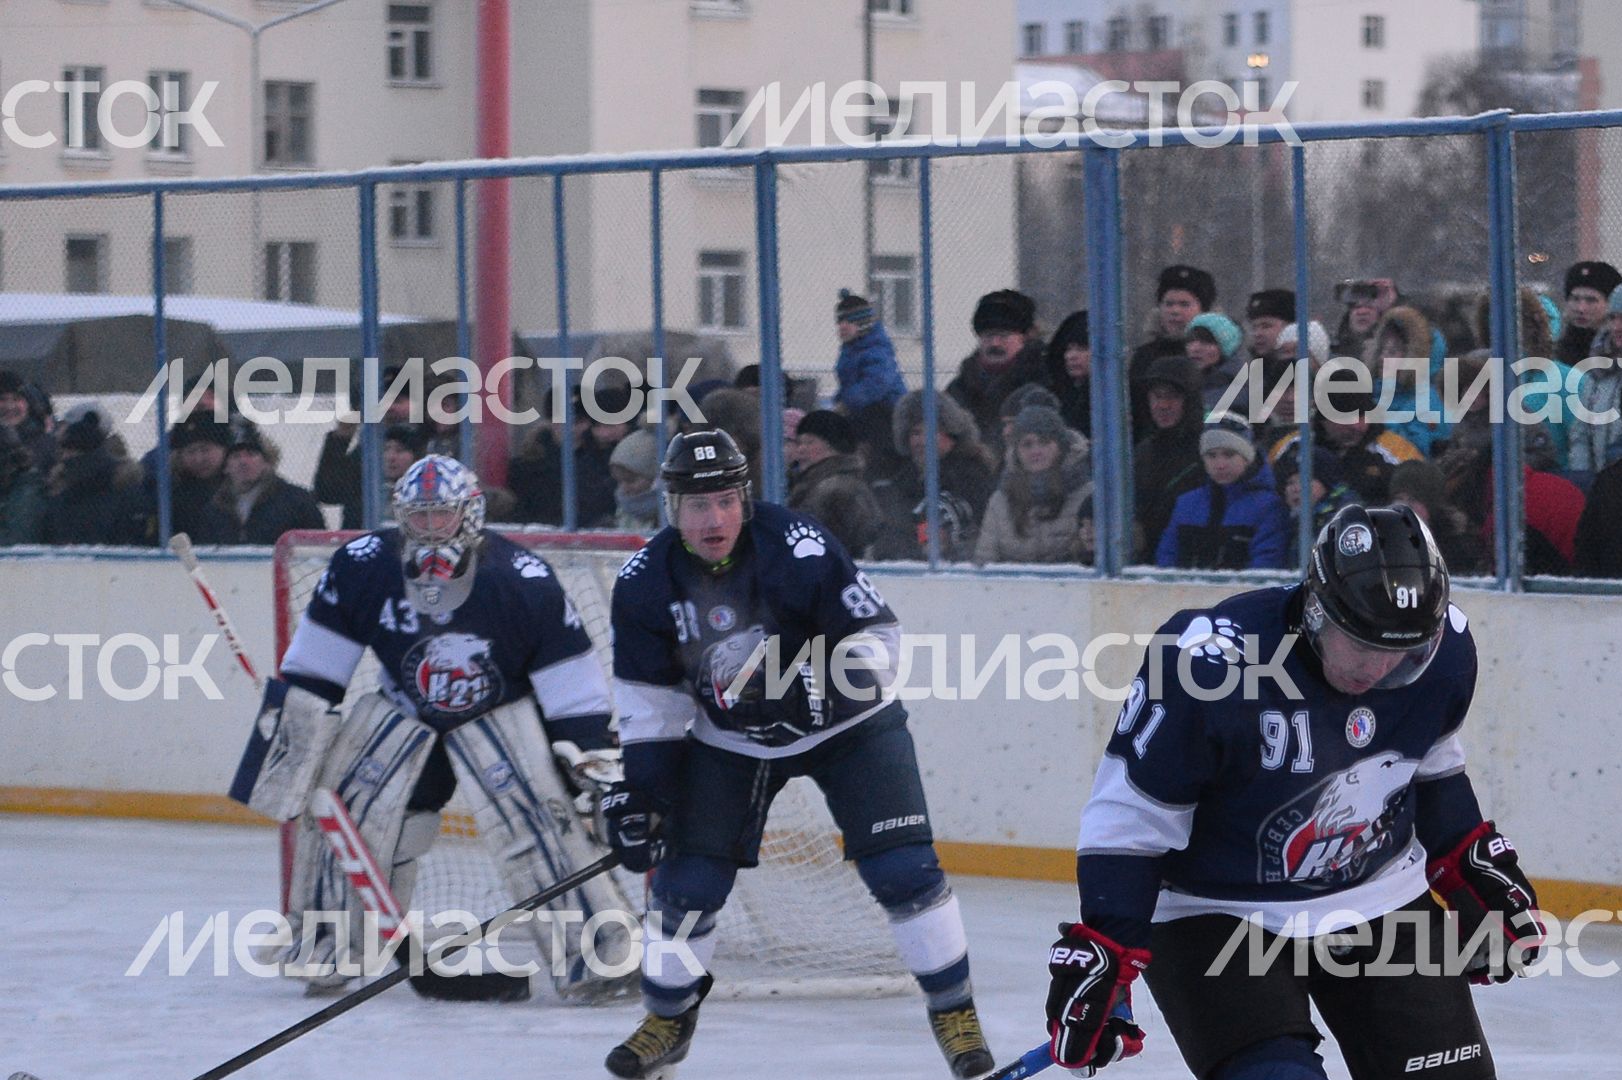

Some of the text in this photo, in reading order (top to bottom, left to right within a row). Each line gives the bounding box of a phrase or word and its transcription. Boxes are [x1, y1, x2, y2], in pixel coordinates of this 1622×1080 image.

[693, 445, 716, 461] 88
[1396, 587, 1418, 609] 91
[379, 597, 420, 633] 43
[1116, 676, 1166, 760] 91
[1259, 710, 1315, 773] 91
[1404, 1043, 1482, 1073] BAUER
